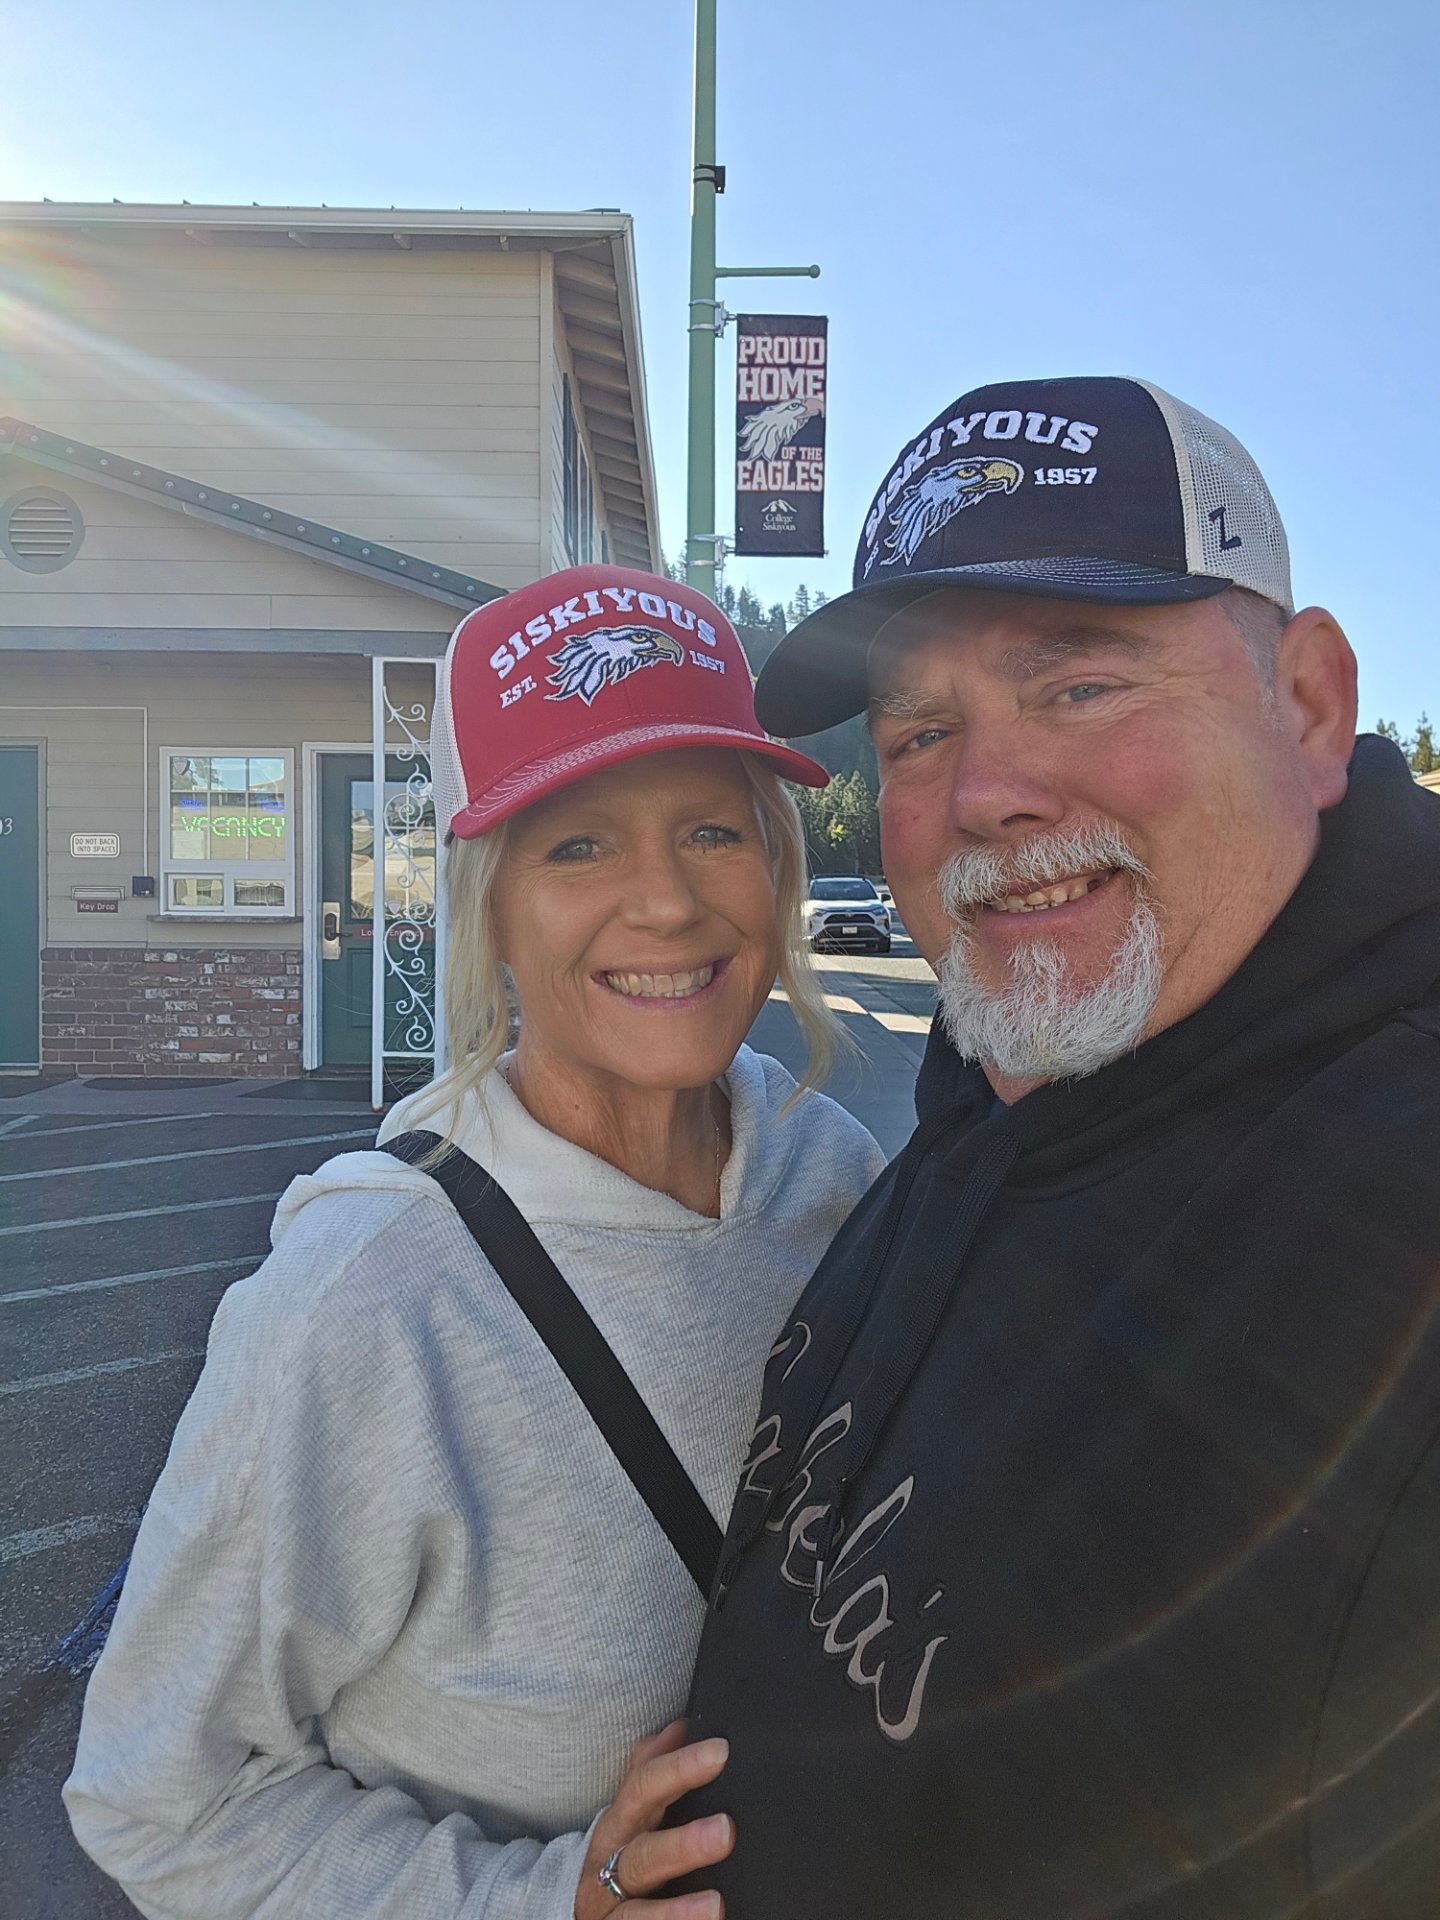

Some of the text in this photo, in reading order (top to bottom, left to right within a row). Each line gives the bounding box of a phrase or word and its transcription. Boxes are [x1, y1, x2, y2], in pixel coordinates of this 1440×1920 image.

[738, 335, 826, 366] PROUD
[738, 367, 825, 402] HOME
[781, 447, 822, 460] OF THE
[737, 460, 824, 492] EAGLES
[866, 410, 1100, 548] SISKIYOUS
[1033, 466, 1098, 486] 1957
[765, 513, 793, 524] College
[489, 587, 718, 680] SISKIYOUS
[499, 650, 727, 709] EST. 1957
[180, 815, 286, 838] VACANCY
[80, 903, 116, 911] Key Drop
